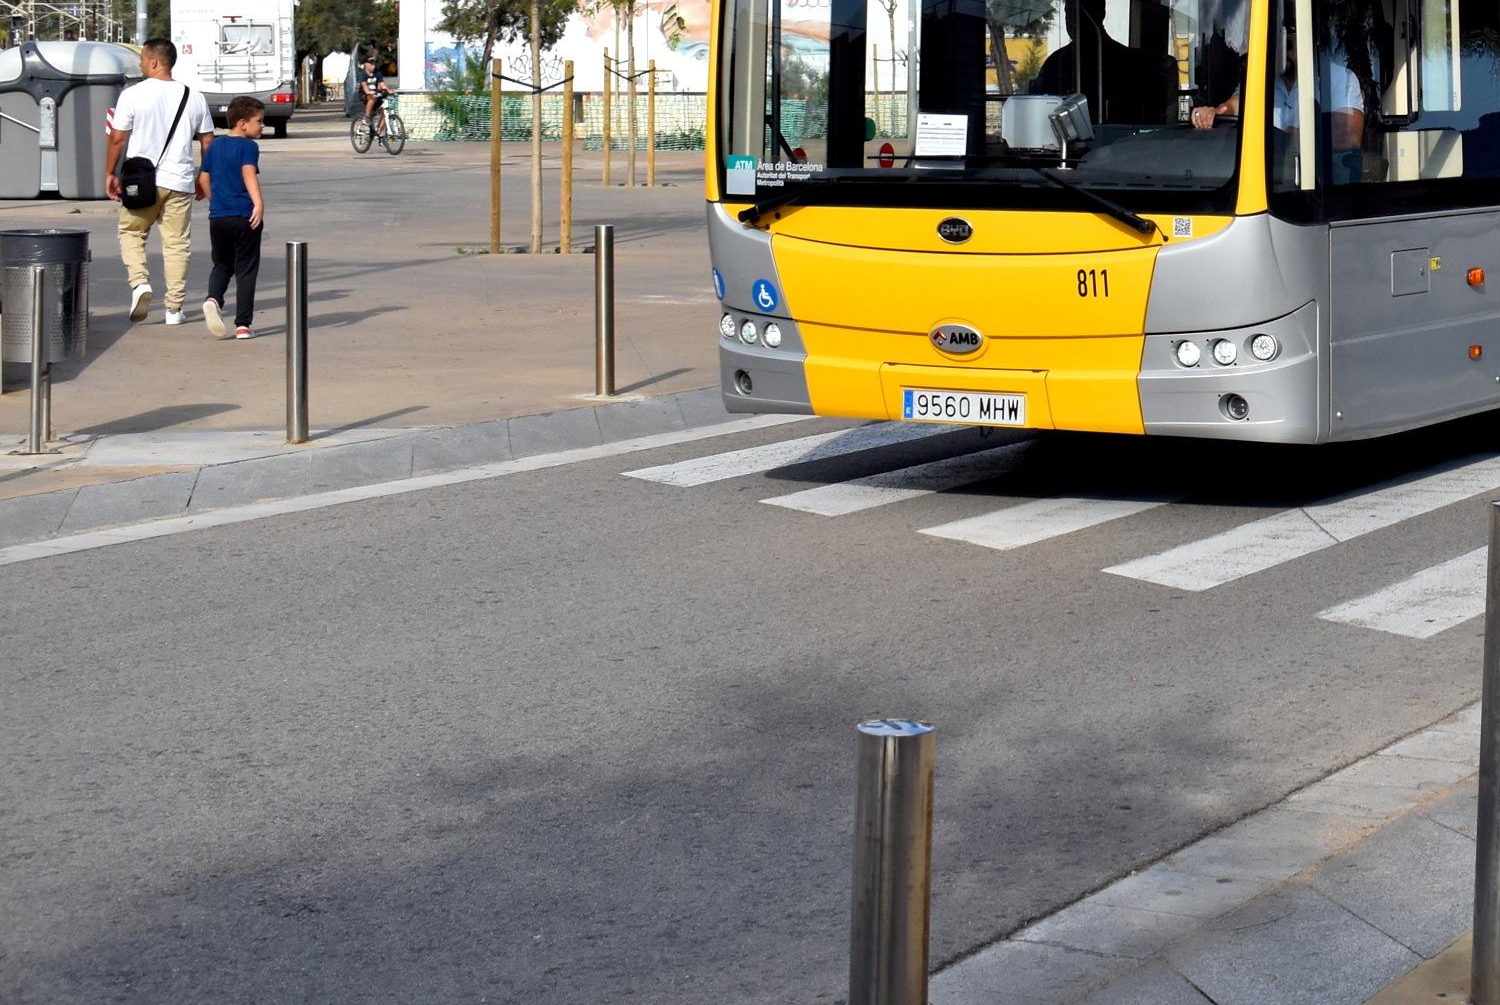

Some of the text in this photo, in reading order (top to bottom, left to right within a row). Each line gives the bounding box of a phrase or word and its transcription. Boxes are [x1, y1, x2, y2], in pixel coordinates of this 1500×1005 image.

[735, 160, 753, 170] ATM
[775, 161, 784, 171] de
[786, 161, 823, 172] Barcelona
[787, 172, 811, 181] Transport
[756, 179, 785, 187] Metropolità
[940, 223, 970, 237] BYD
[1077, 268, 1109, 298] 811
[949, 331, 979, 345] AMB
[917, 394, 971, 418] 9560
[979, 397, 1019, 421] MHW
